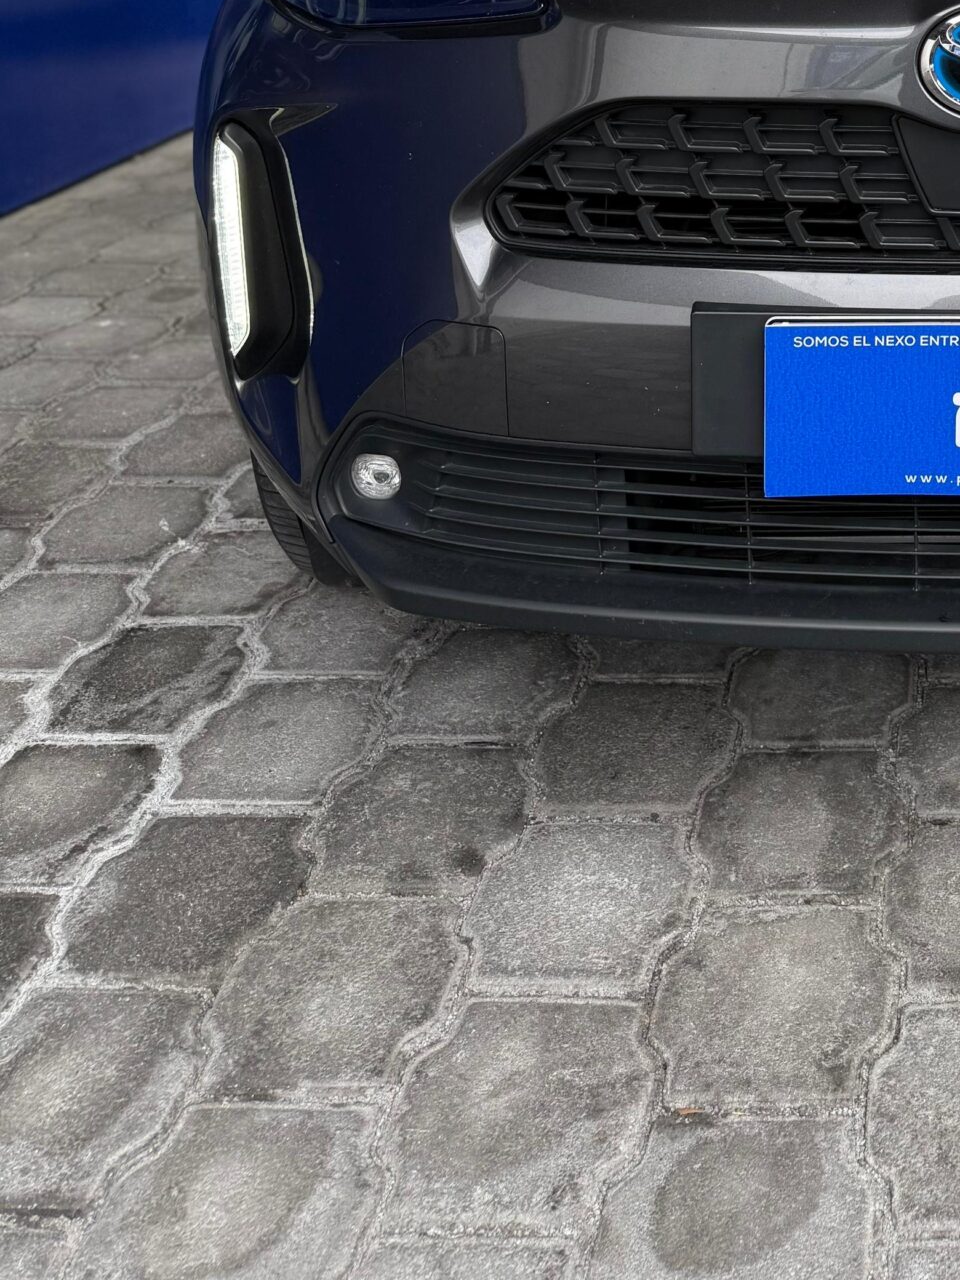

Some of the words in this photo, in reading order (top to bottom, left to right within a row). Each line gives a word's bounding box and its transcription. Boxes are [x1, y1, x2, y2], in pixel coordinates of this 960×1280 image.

[793, 335, 849, 348] SOMOS
[853, 335, 871, 347] EL
[874, 335, 916, 347] NEXO
